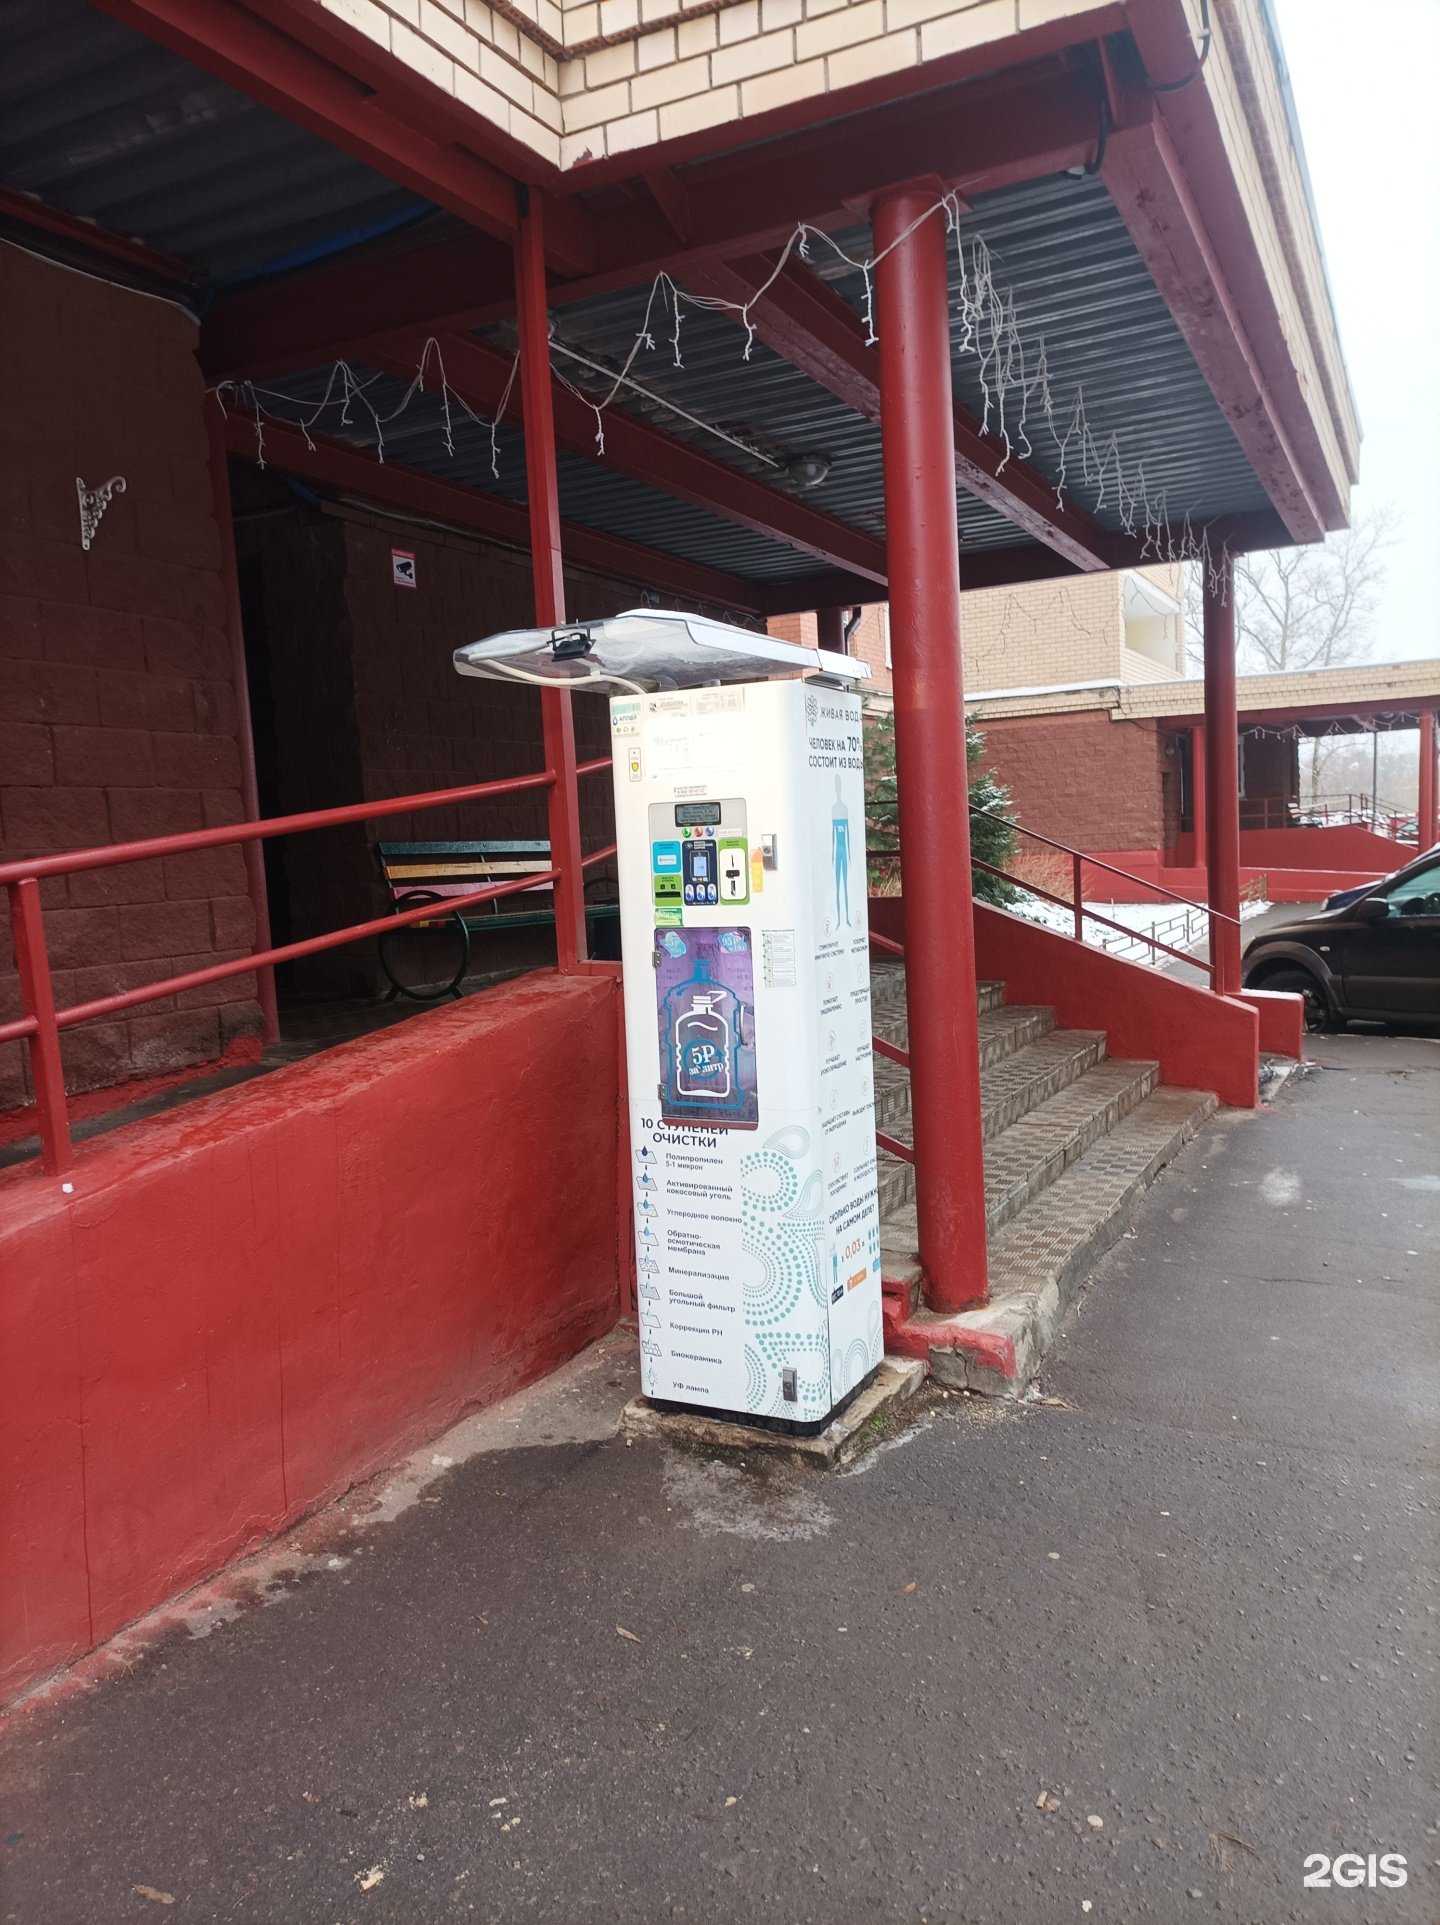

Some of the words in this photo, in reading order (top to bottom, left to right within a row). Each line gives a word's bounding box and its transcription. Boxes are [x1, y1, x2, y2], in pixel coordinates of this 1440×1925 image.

[820, 706, 843, 720] ЖИВАЯ
[808, 736, 835, 750] ЧЕЛОВЕК
[836, 739, 846, 751] НА
[808, 755, 837, 769] СОСТОИТ
[838, 757, 846, 769] ИЗ
[641, 1118, 653, 1129] 10
[652, 1132, 717, 1148] ОЧИСТКИ
[666, 1152, 723, 1165] Полипропилен
[677, 1163, 703, 1171] микрон
[666, 1180, 733, 1193] Активированный
[666, 1188, 708, 1197] кокосовый
[709, 1192, 732, 1200] уголь
[667, 1208, 709, 1220] Углеродное
[710, 1214, 743, 1223] волокно
[828, 1203, 849, 1225] СКОЛЬКО
[835, 1224, 843, 1235] НА
[843, 1213, 861, 1230] САМОМ
[667, 1238, 721, 1250] осмотическая
[667, 1246, 706, 1256] мембрана
[668, 1266, 730, 1281] Минерализация
[669, 1289, 703, 1300] Большой
[669, 1297, 706, 1308] угольный
[707, 1301, 736, 1313] фильтр
[670, 1321, 710, 1334] Коррекция
[671, 1350, 722, 1364] Биокерамика
[673, 1381, 684, 1389] УФ
[685, 1384, 709, 1393] лампа
